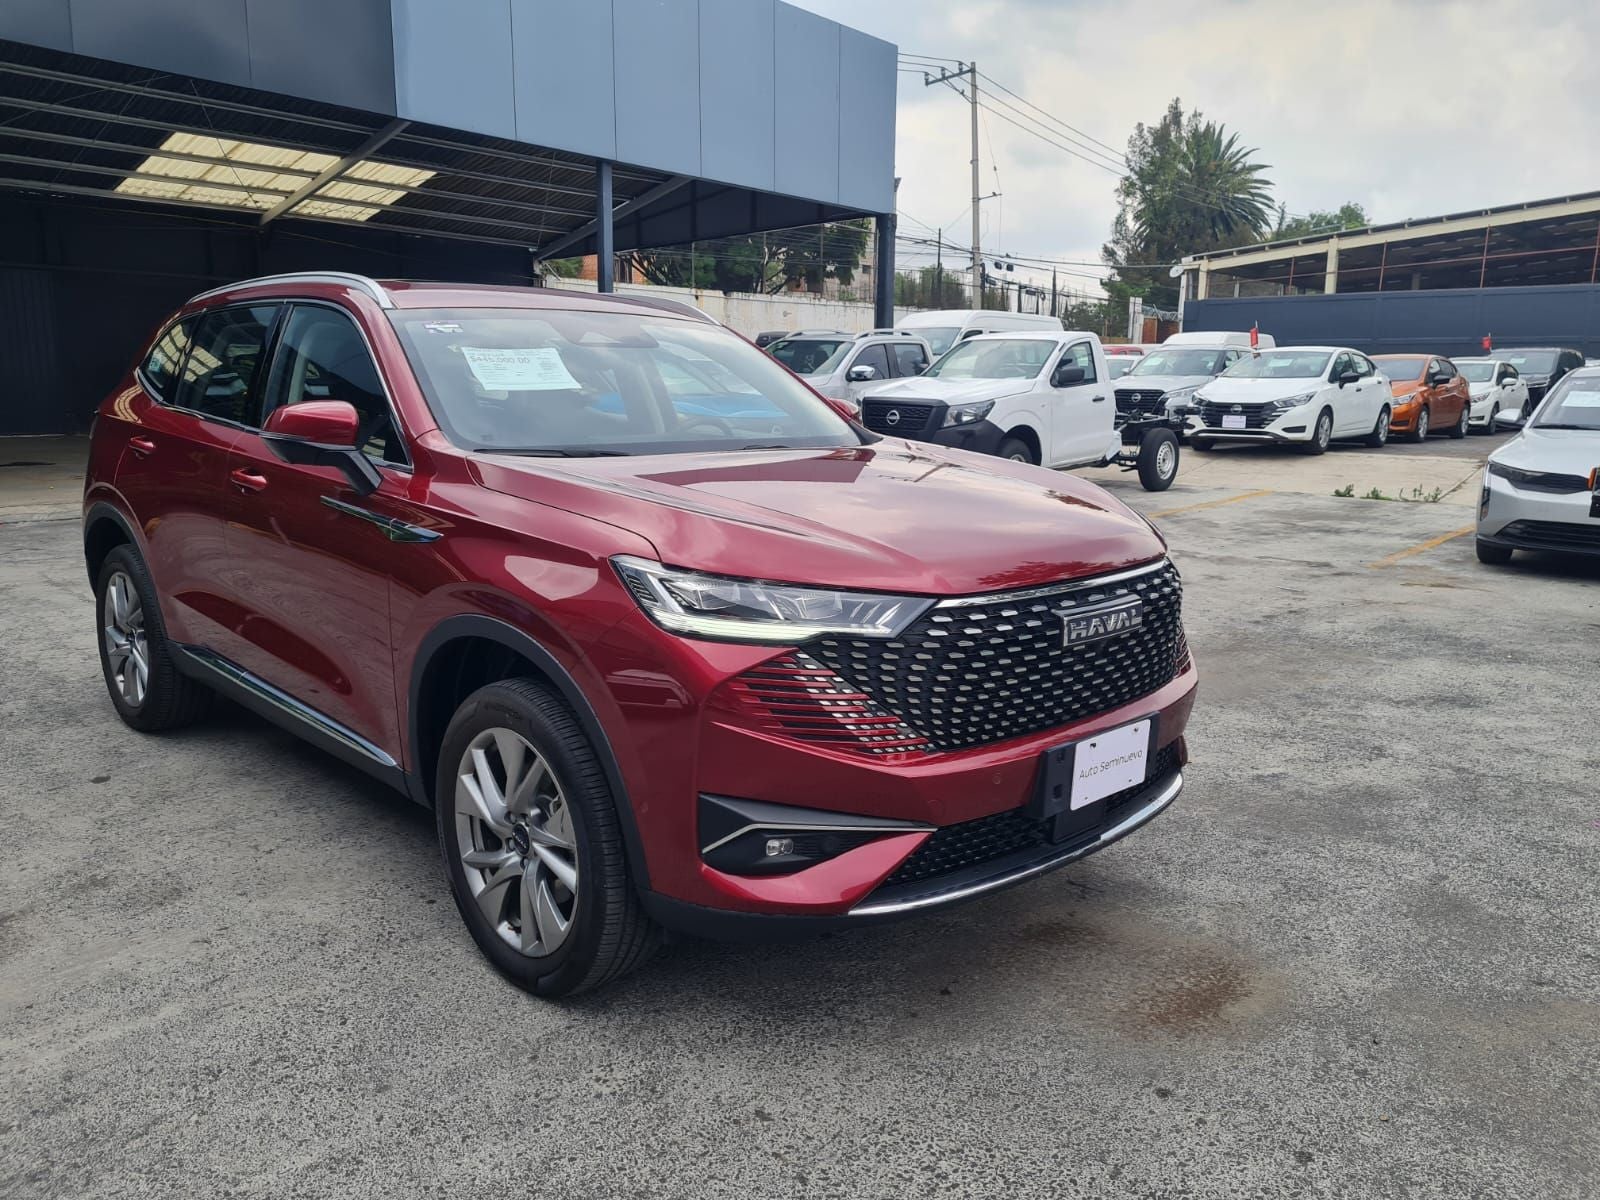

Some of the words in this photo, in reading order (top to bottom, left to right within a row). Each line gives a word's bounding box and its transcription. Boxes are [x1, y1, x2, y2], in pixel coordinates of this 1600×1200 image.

[1070, 608, 1142, 640] HAVAL
[1079, 765, 1099, 779] Auto
[1100, 750, 1143, 773] Seminuevo
